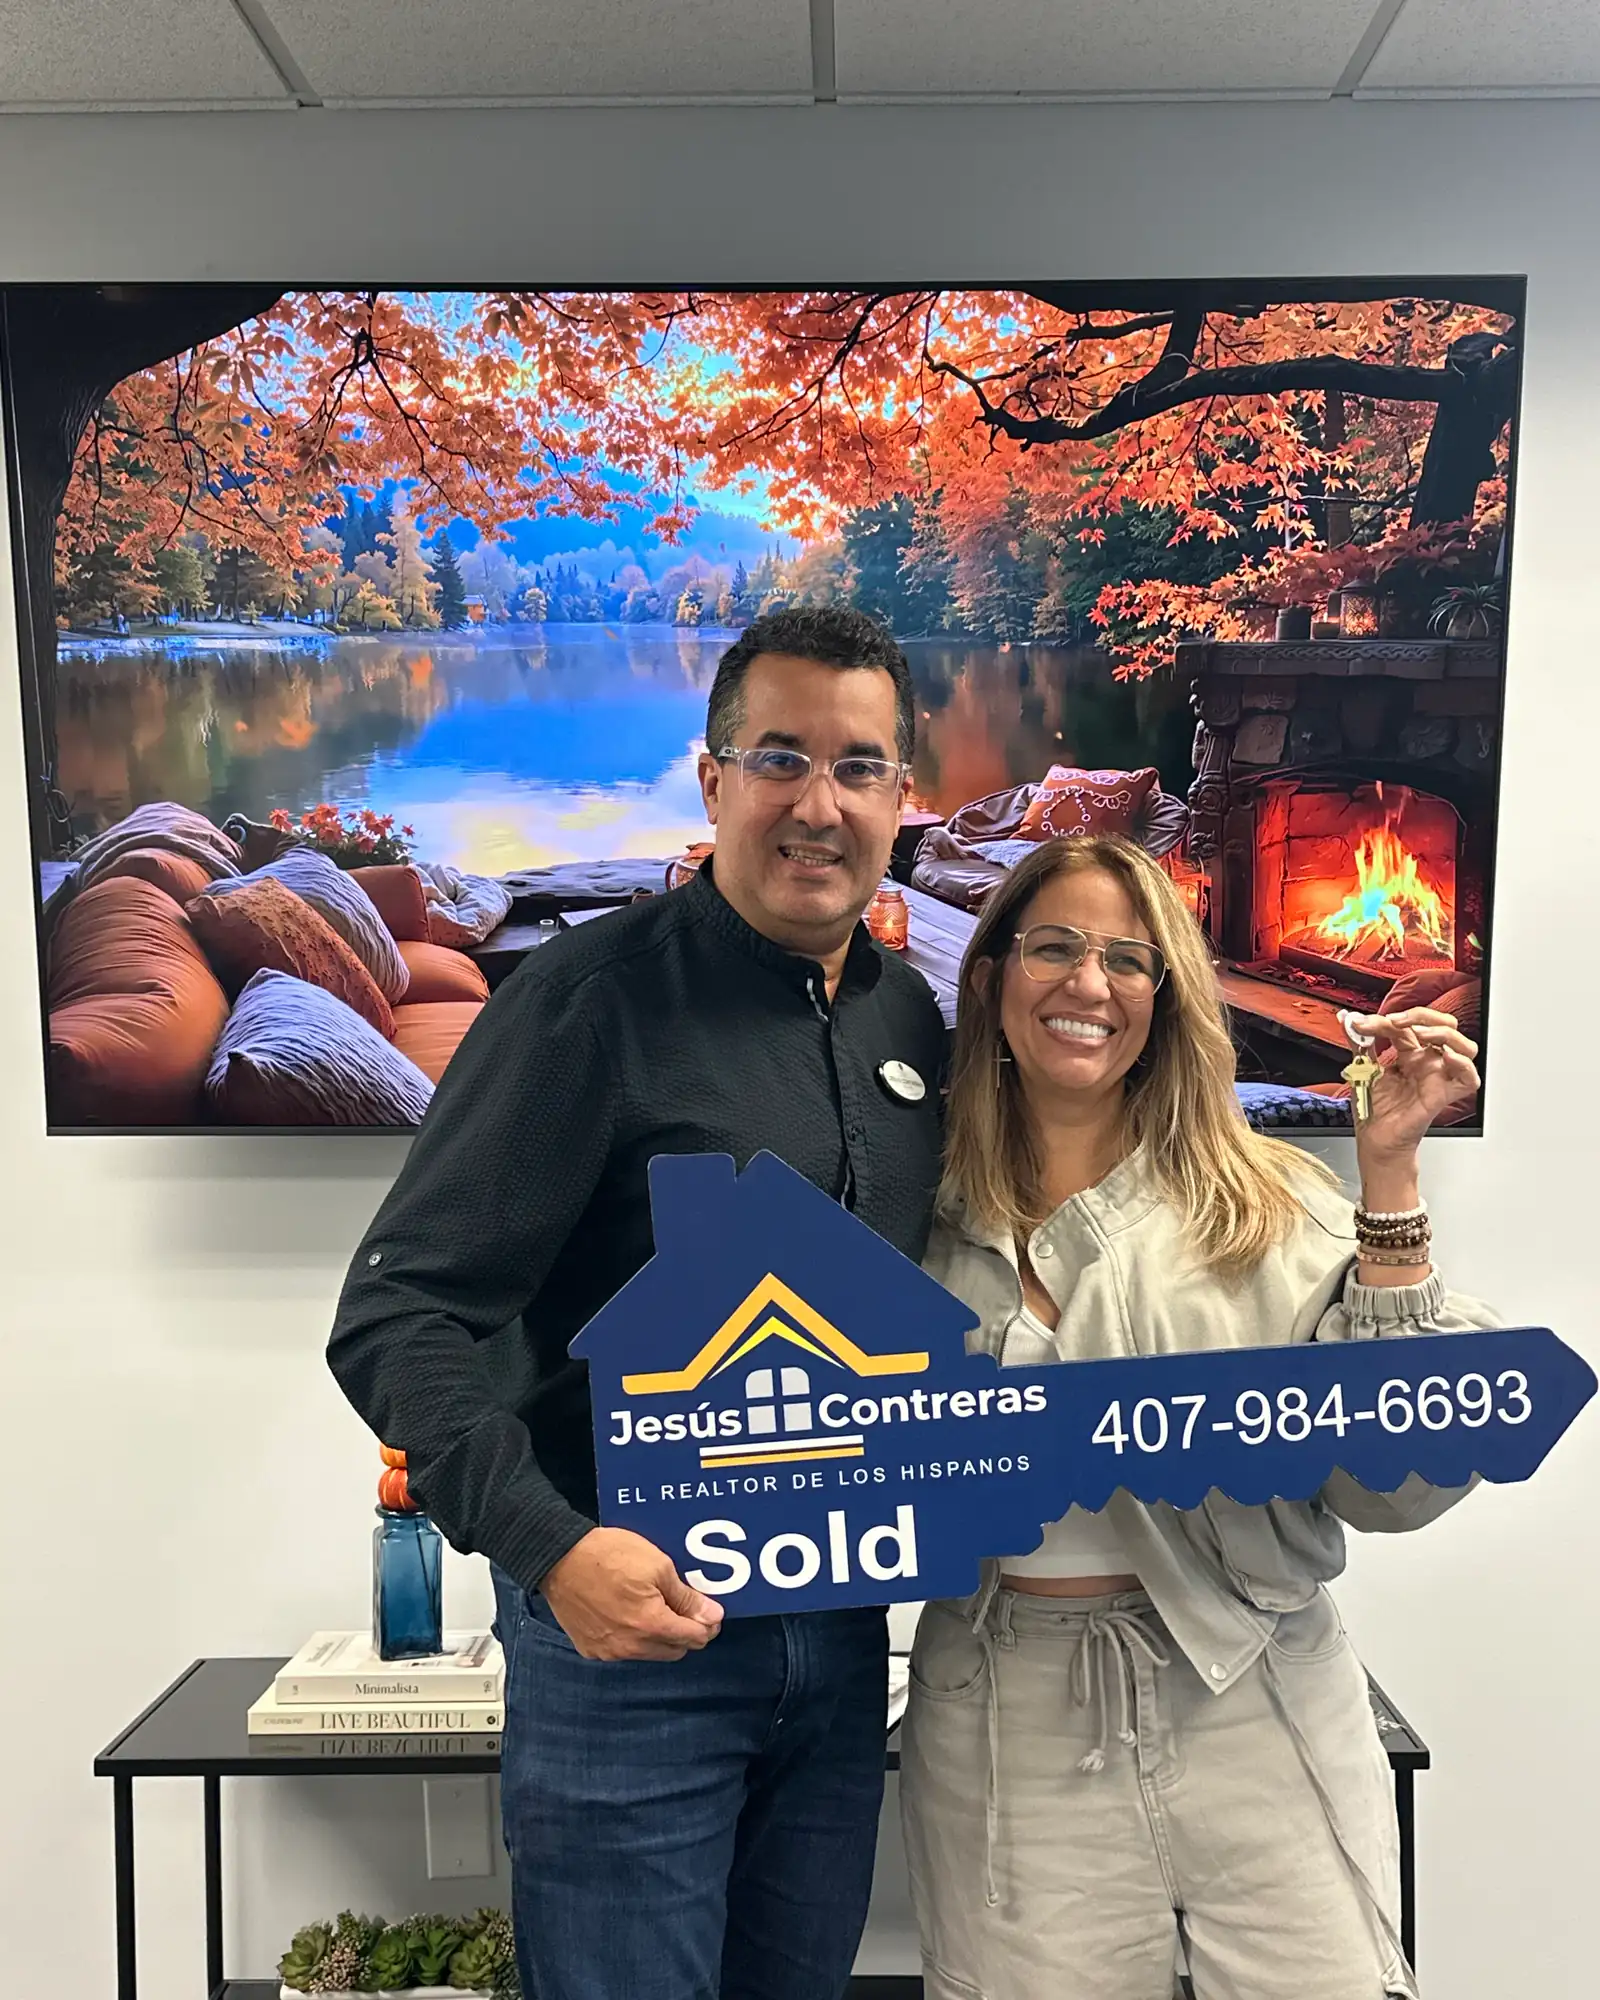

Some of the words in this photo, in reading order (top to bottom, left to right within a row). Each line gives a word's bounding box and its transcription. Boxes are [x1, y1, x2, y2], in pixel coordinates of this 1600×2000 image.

[609, 1402, 743, 1446] Jesús
[818, 1385, 1047, 1428] Contreras
[1091, 1369, 1532, 1455] 407-984-6693
[617, 1488, 647, 1504] EL
[660, 1477, 778, 1501] REALTOR
[792, 1472, 825, 1490] DE
[838, 1467, 887, 1486] LOS
[900, 1455, 1031, 1481] HISPANOS
[684, 1504, 919, 1595] Sold
[355, 1683, 419, 1696] Minimalista
[320, 1712, 361, 1730] LIVE
[366, 1711, 471, 1729] BEAUTIFUL
